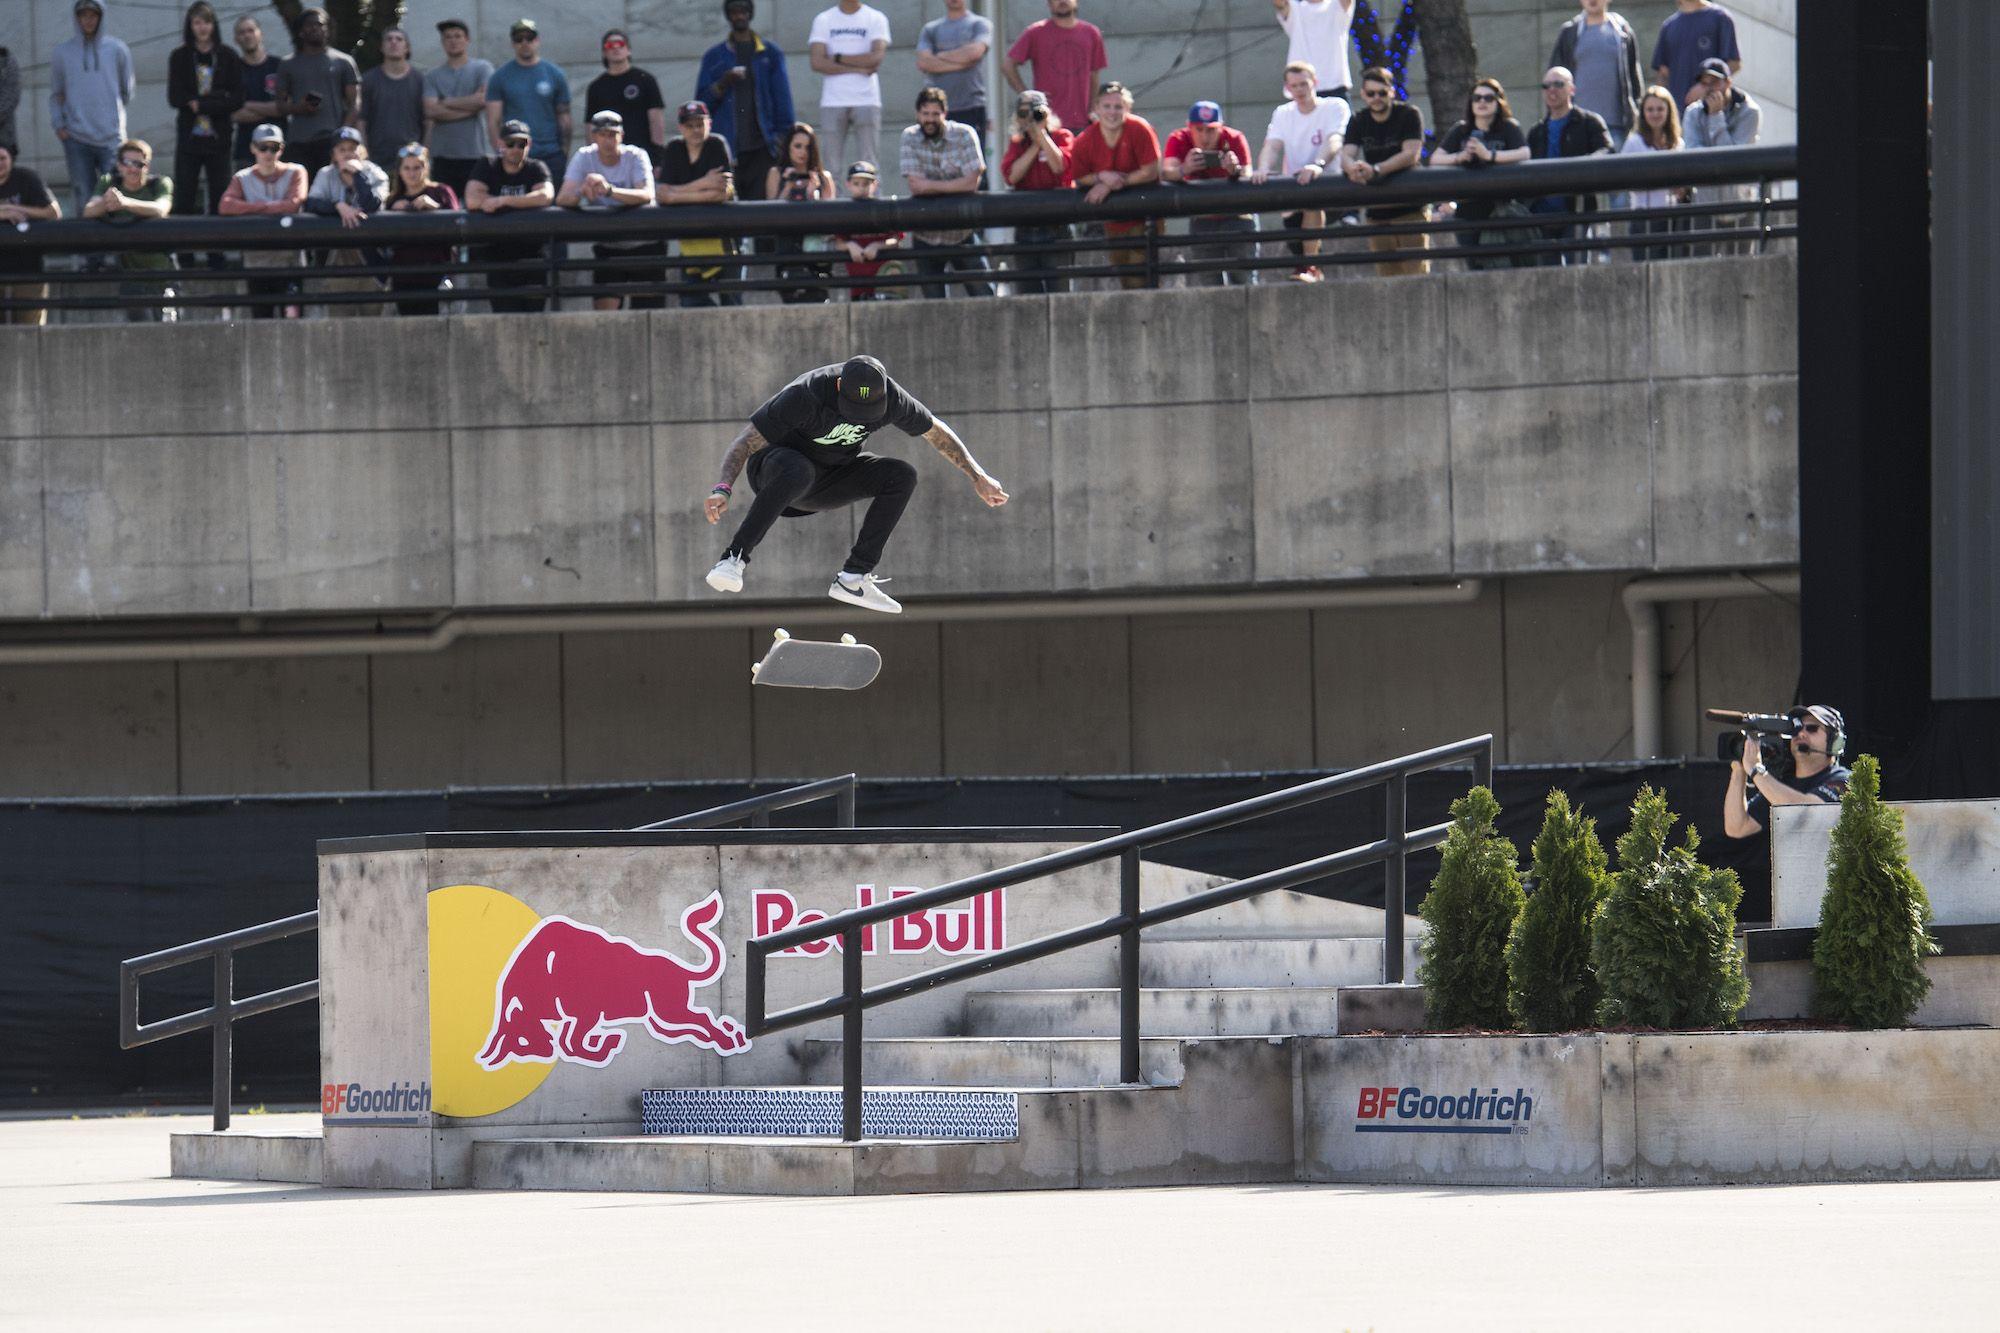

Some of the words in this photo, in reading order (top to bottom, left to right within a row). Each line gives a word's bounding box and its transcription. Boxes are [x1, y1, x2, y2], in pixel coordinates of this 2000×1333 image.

[892, 888, 1003, 952] Bull
[322, 1081, 432, 1114] BFGoodrich
[1357, 1087, 1533, 1121] BFGoodrich
[1511, 1123, 1529, 1135] Tires
